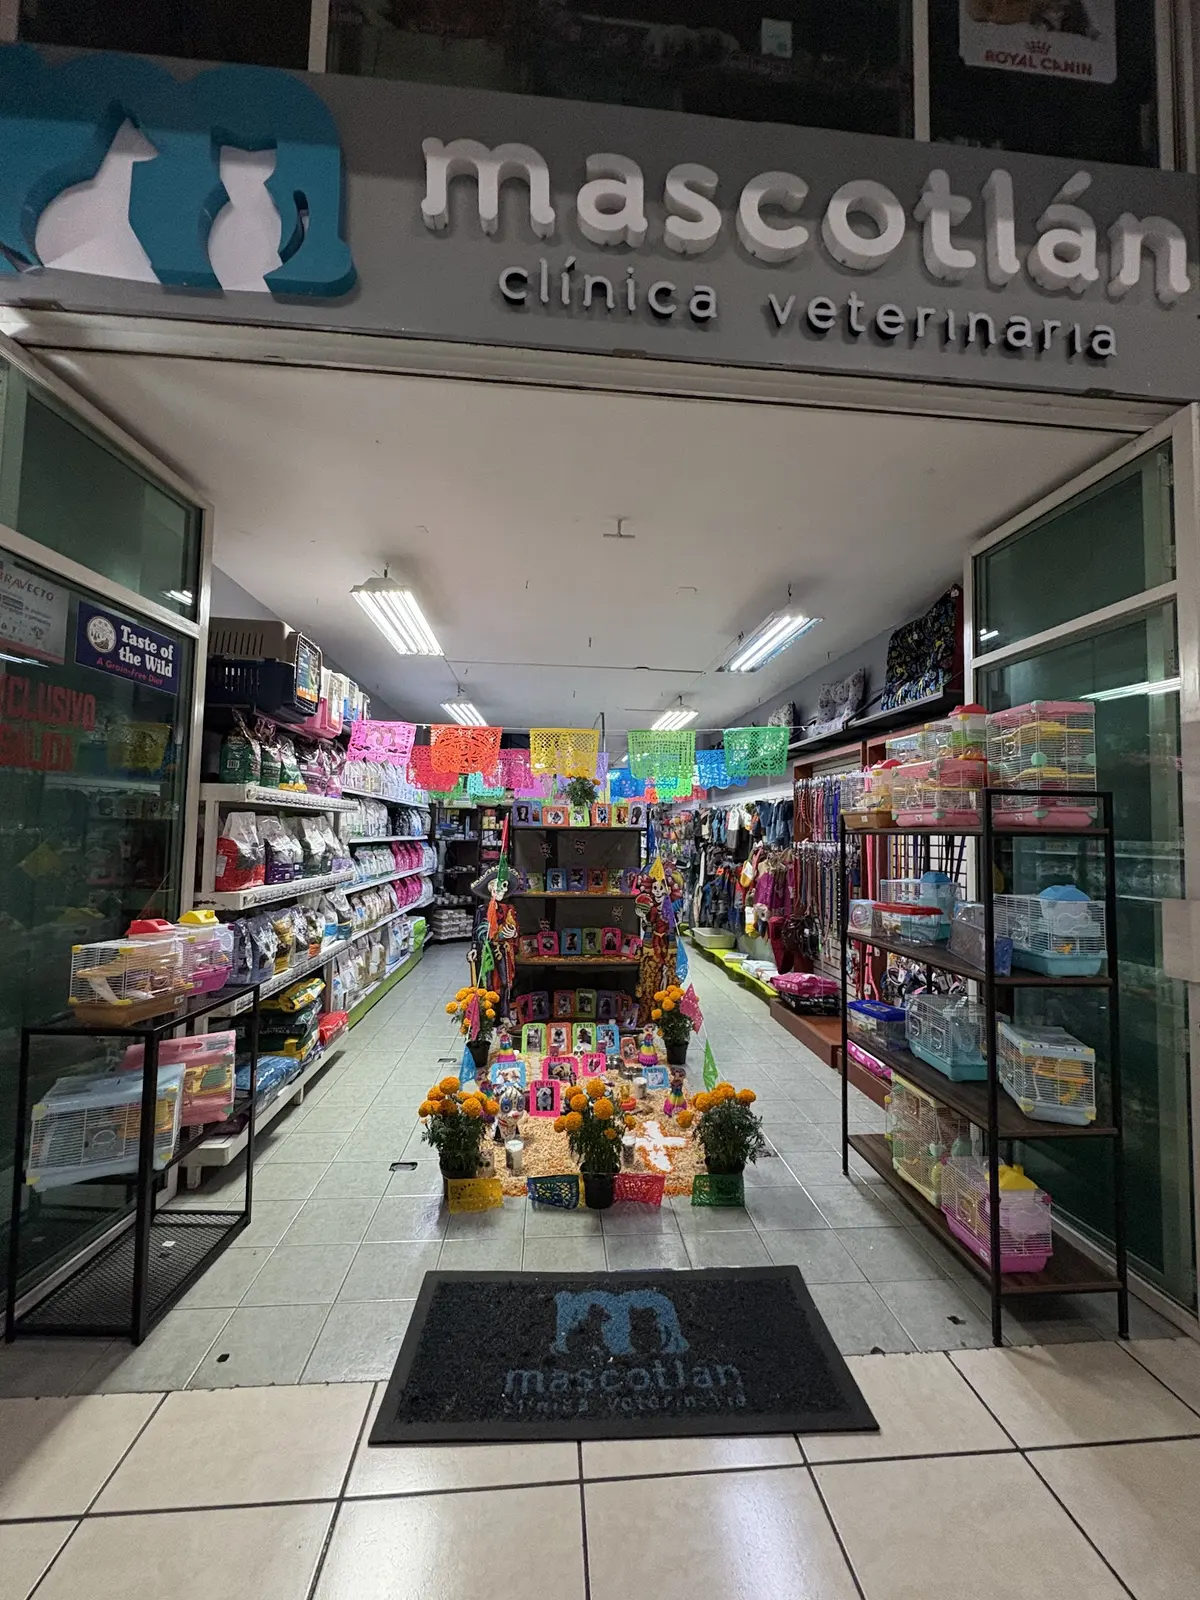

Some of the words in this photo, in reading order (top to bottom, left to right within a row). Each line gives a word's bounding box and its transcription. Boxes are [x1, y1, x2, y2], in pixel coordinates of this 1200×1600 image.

[984, 50, 1038, 69] ROYAL
[1040, 57, 1093, 76] CANIN
[421, 137, 1190, 301] mascotlán
[499, 255, 718, 319] clínica
[767, 290, 1118, 357] veterinaria
[120, 624, 158, 654] Taste
[160, 644, 174, 661] of
[96, 656, 104, 666] A
[119, 646, 142, 666] the
[145, 653, 173, 678] Wild
